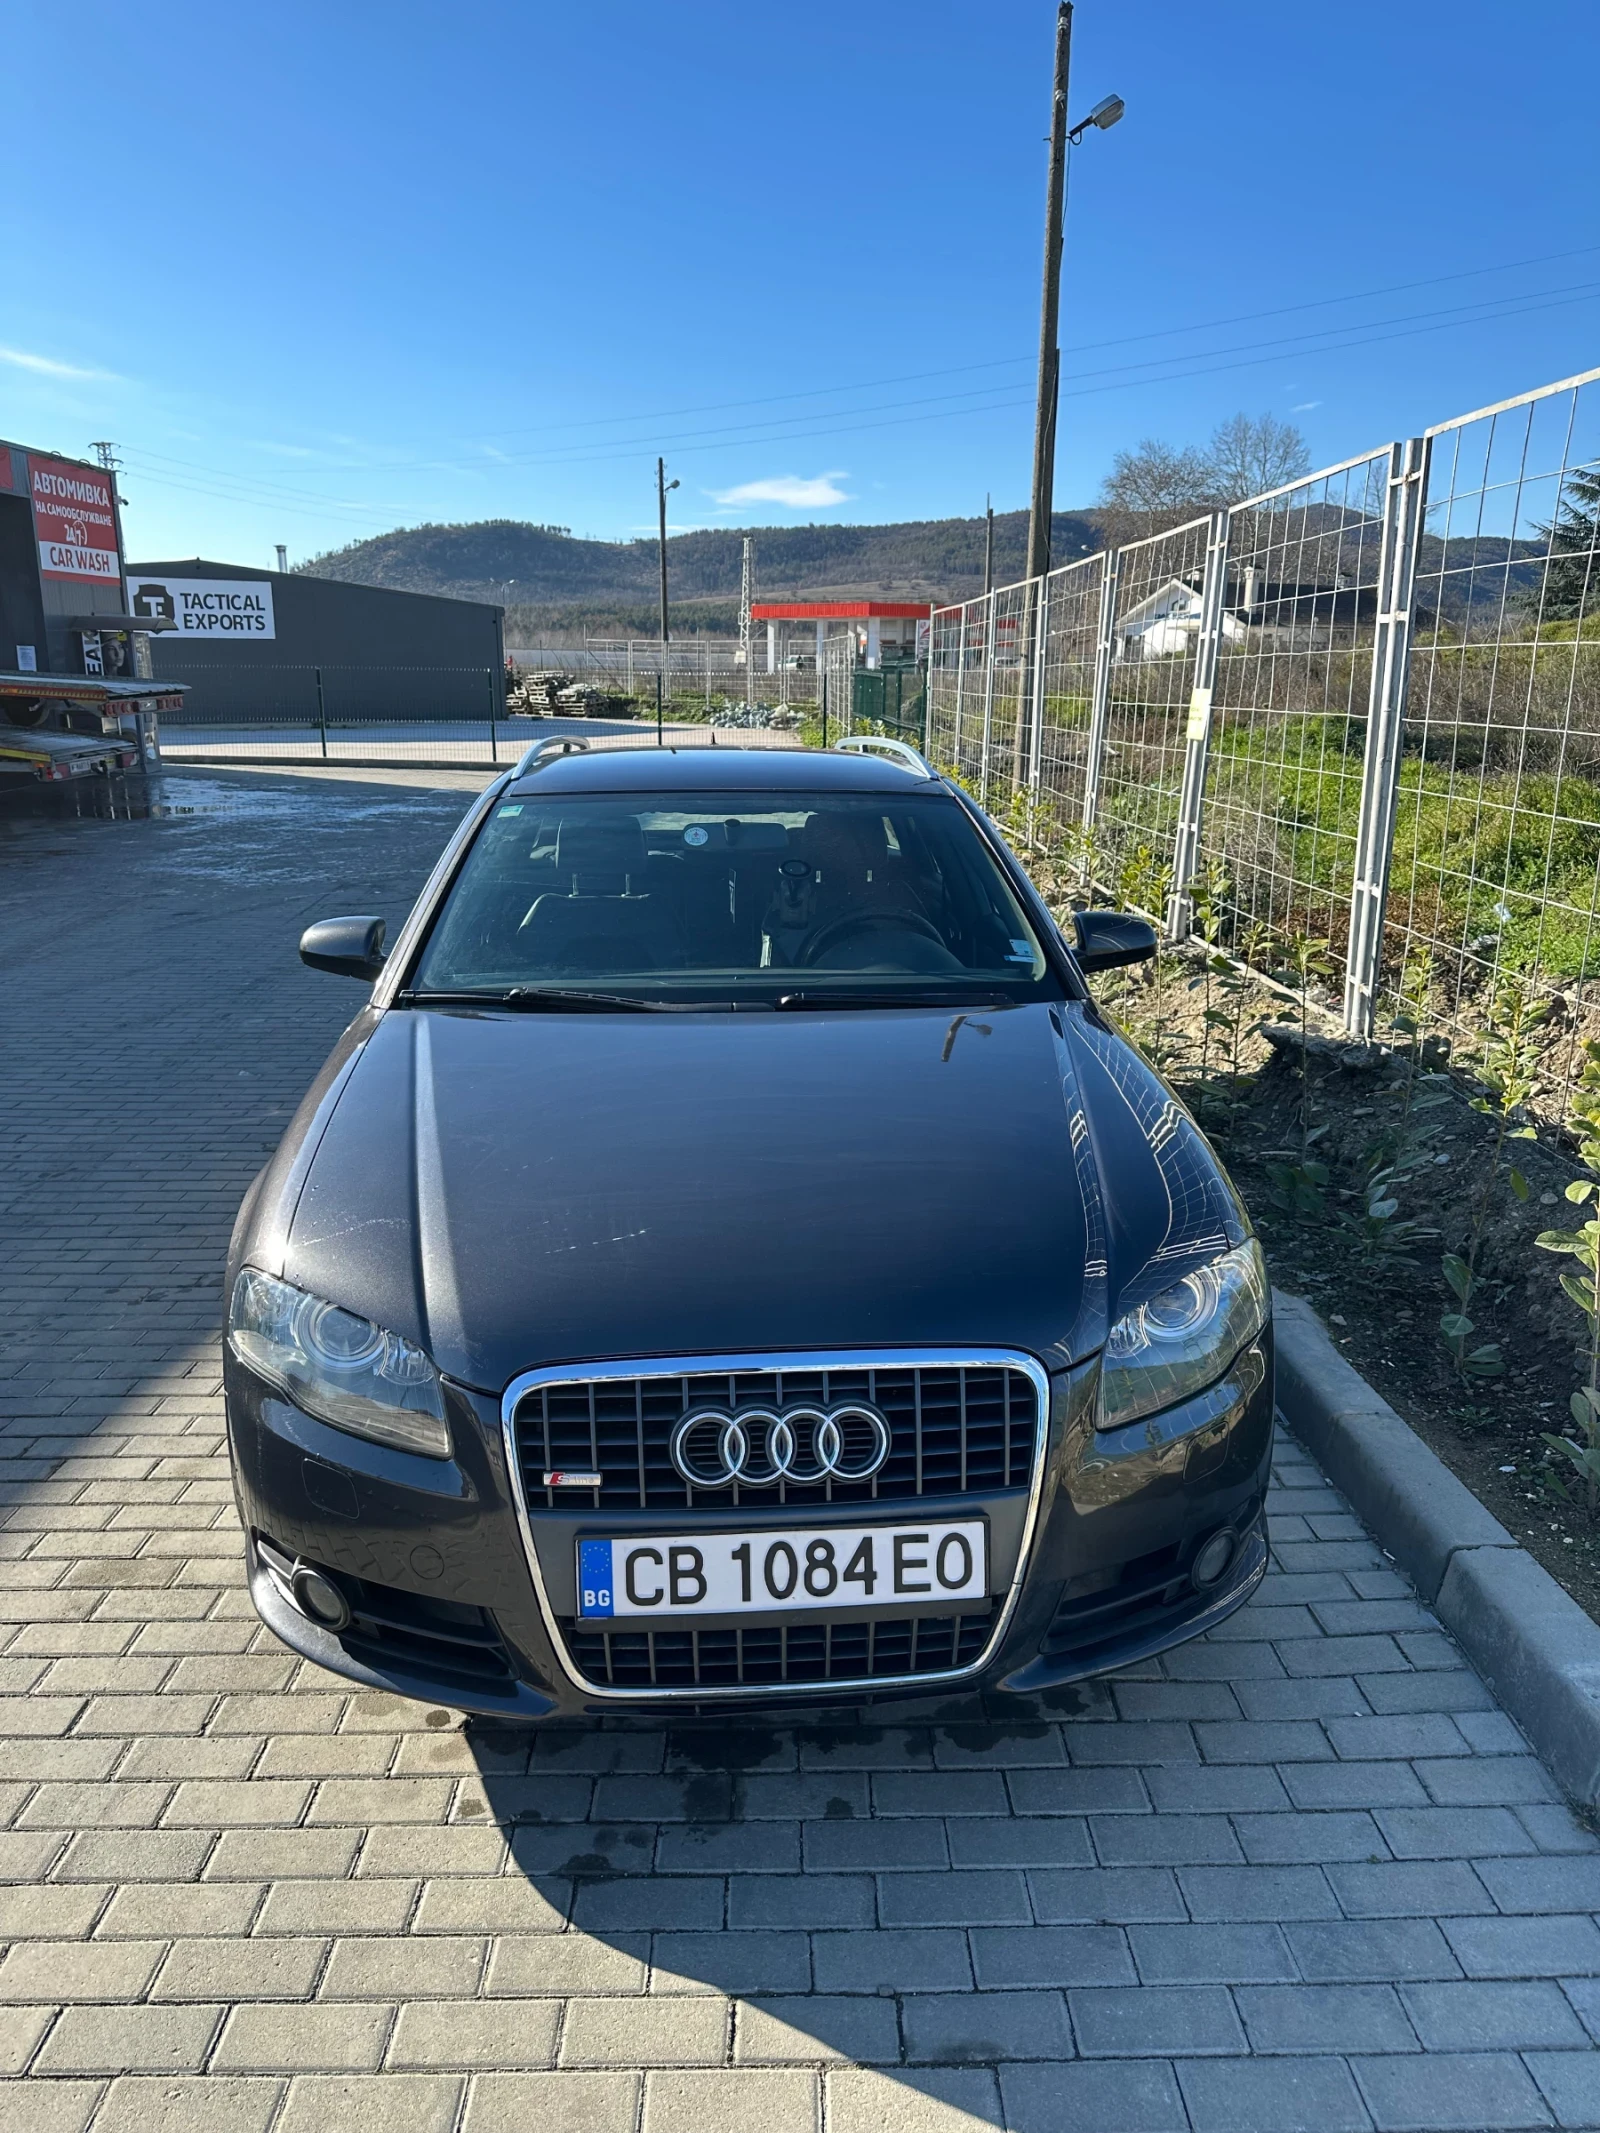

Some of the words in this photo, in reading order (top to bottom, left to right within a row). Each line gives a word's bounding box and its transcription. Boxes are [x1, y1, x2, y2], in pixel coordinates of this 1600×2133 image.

[34, 470, 111, 507] АВТОМИВКА
[35, 500, 47, 514] НА
[47, 502, 112, 527] САМООБСЛУЖВАНЕ
[50, 546, 74, 568] CAR
[75, 550, 110, 573] WASH
[180, 593, 265, 611] TACTICAL
[183, 613, 265, 631] EXPORTS
[625, 1546, 708, 1606] CB
[731, 1537, 878, 1603] 1084
[893, 1532, 974, 1594] EO
[584, 1589, 610, 1607] BG
